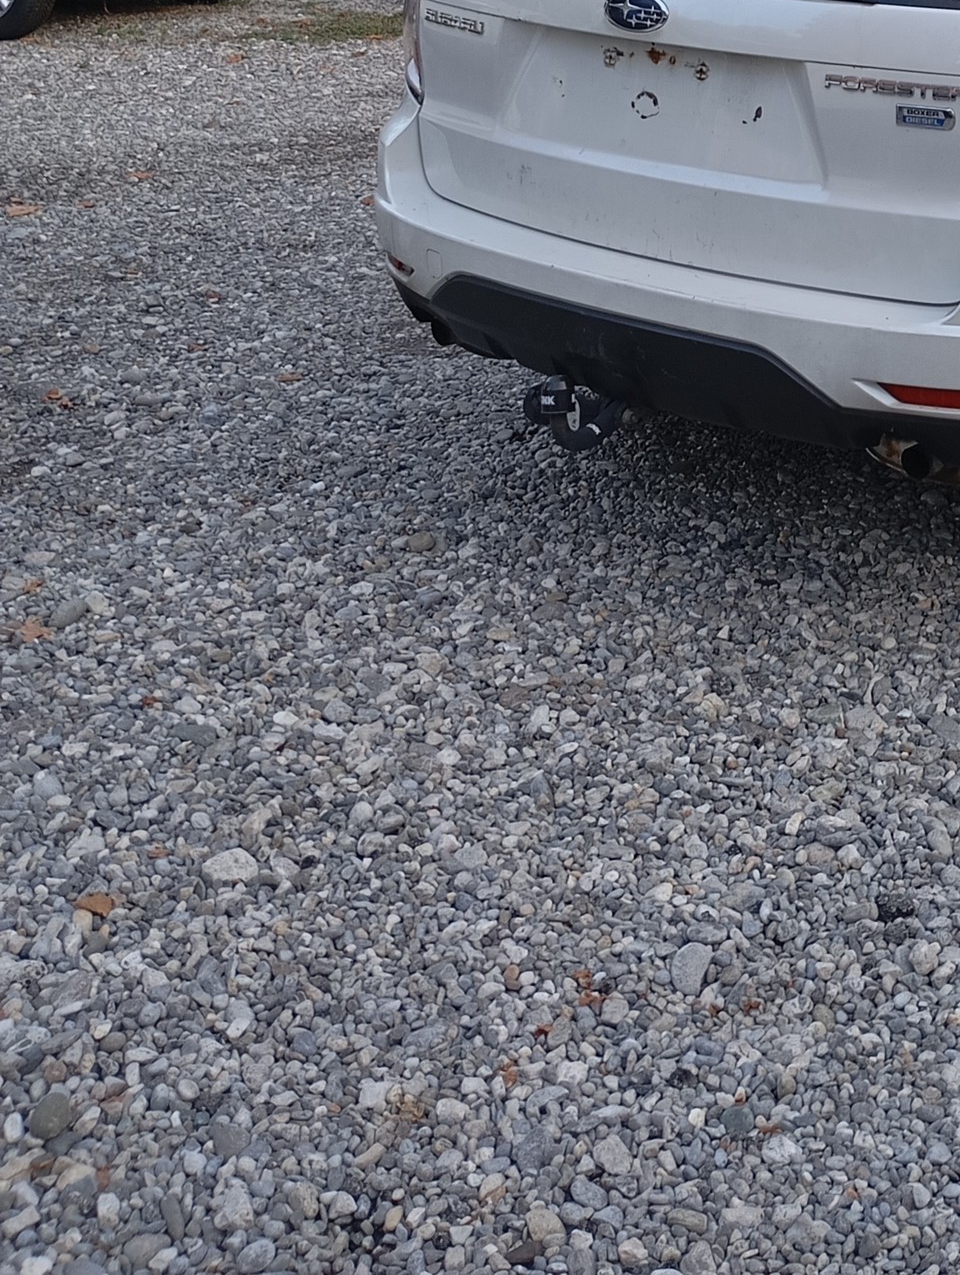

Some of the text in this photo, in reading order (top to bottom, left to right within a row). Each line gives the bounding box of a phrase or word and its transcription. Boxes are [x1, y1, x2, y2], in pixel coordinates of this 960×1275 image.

[424, 8, 485, 35] SUBARU
[906, 108, 940, 117] BOXER
[905, 116, 941, 126] DIESEL
